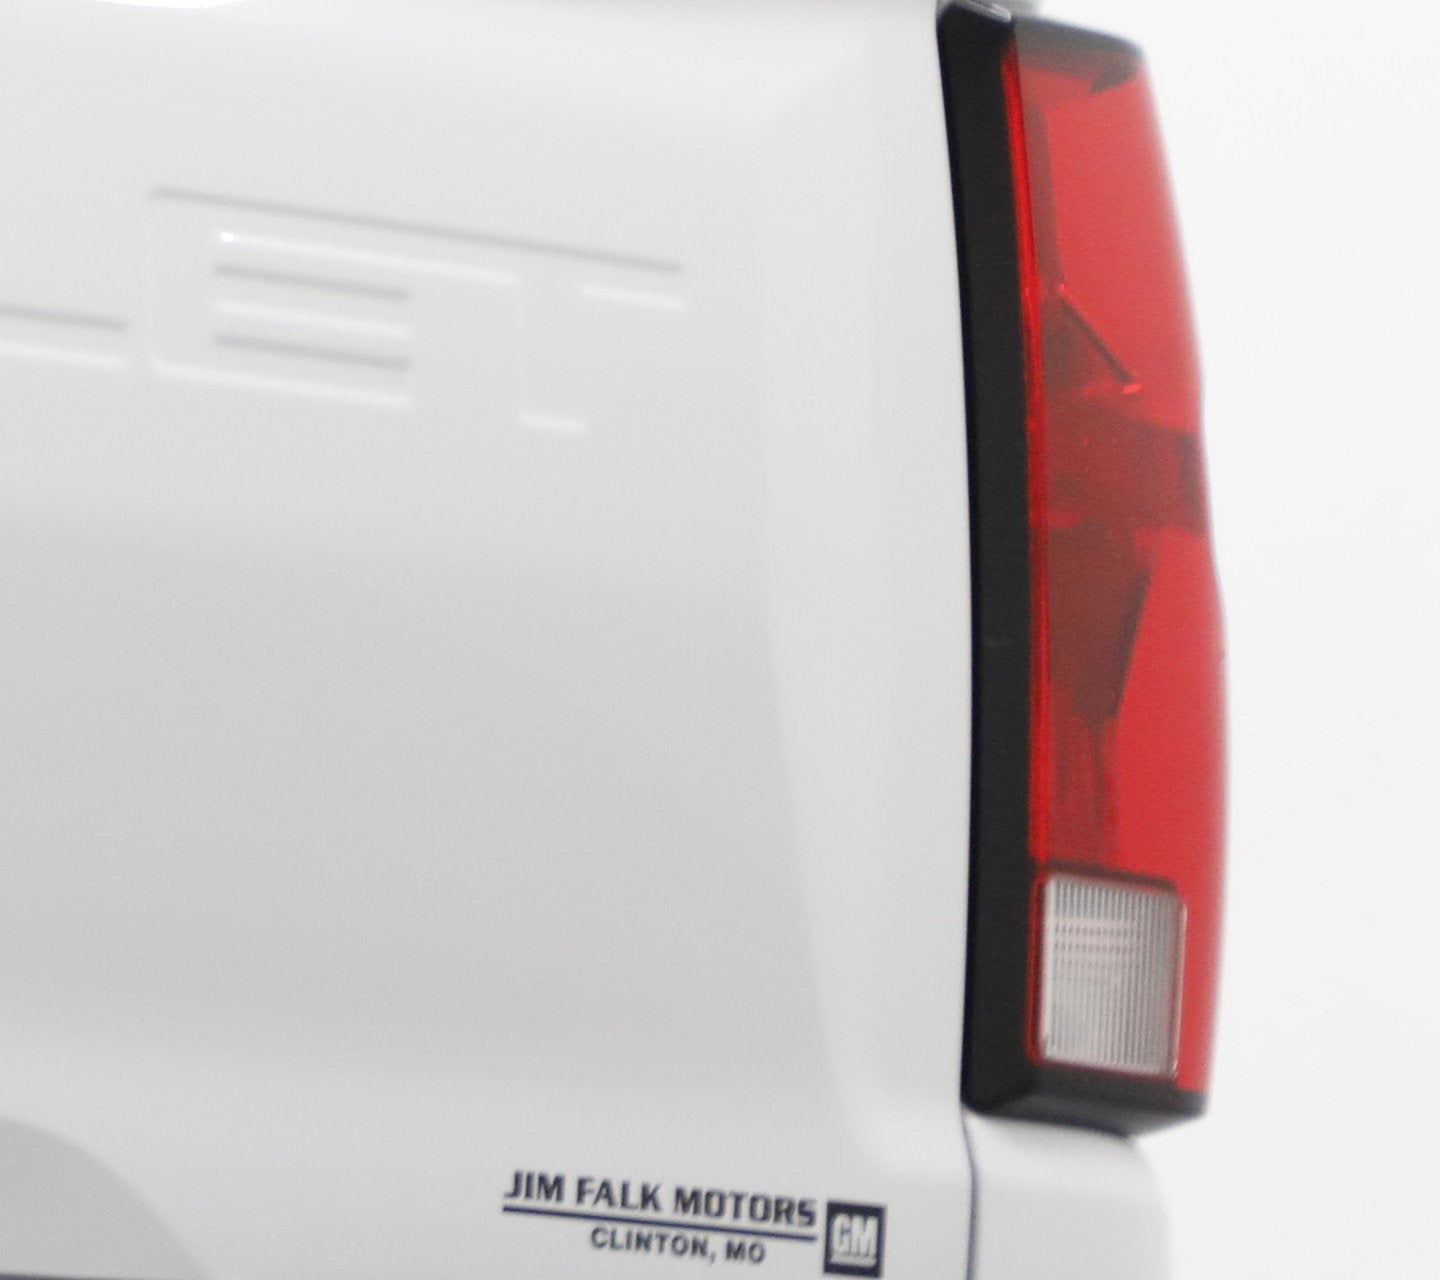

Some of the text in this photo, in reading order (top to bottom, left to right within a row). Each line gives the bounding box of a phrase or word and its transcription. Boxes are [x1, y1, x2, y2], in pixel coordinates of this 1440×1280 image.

[504, 1169, 817, 1228] JIM FALK MOTORS
[589, 1225, 767, 1265] CLINTON, MO
[832, 1212, 878, 1258] GM
